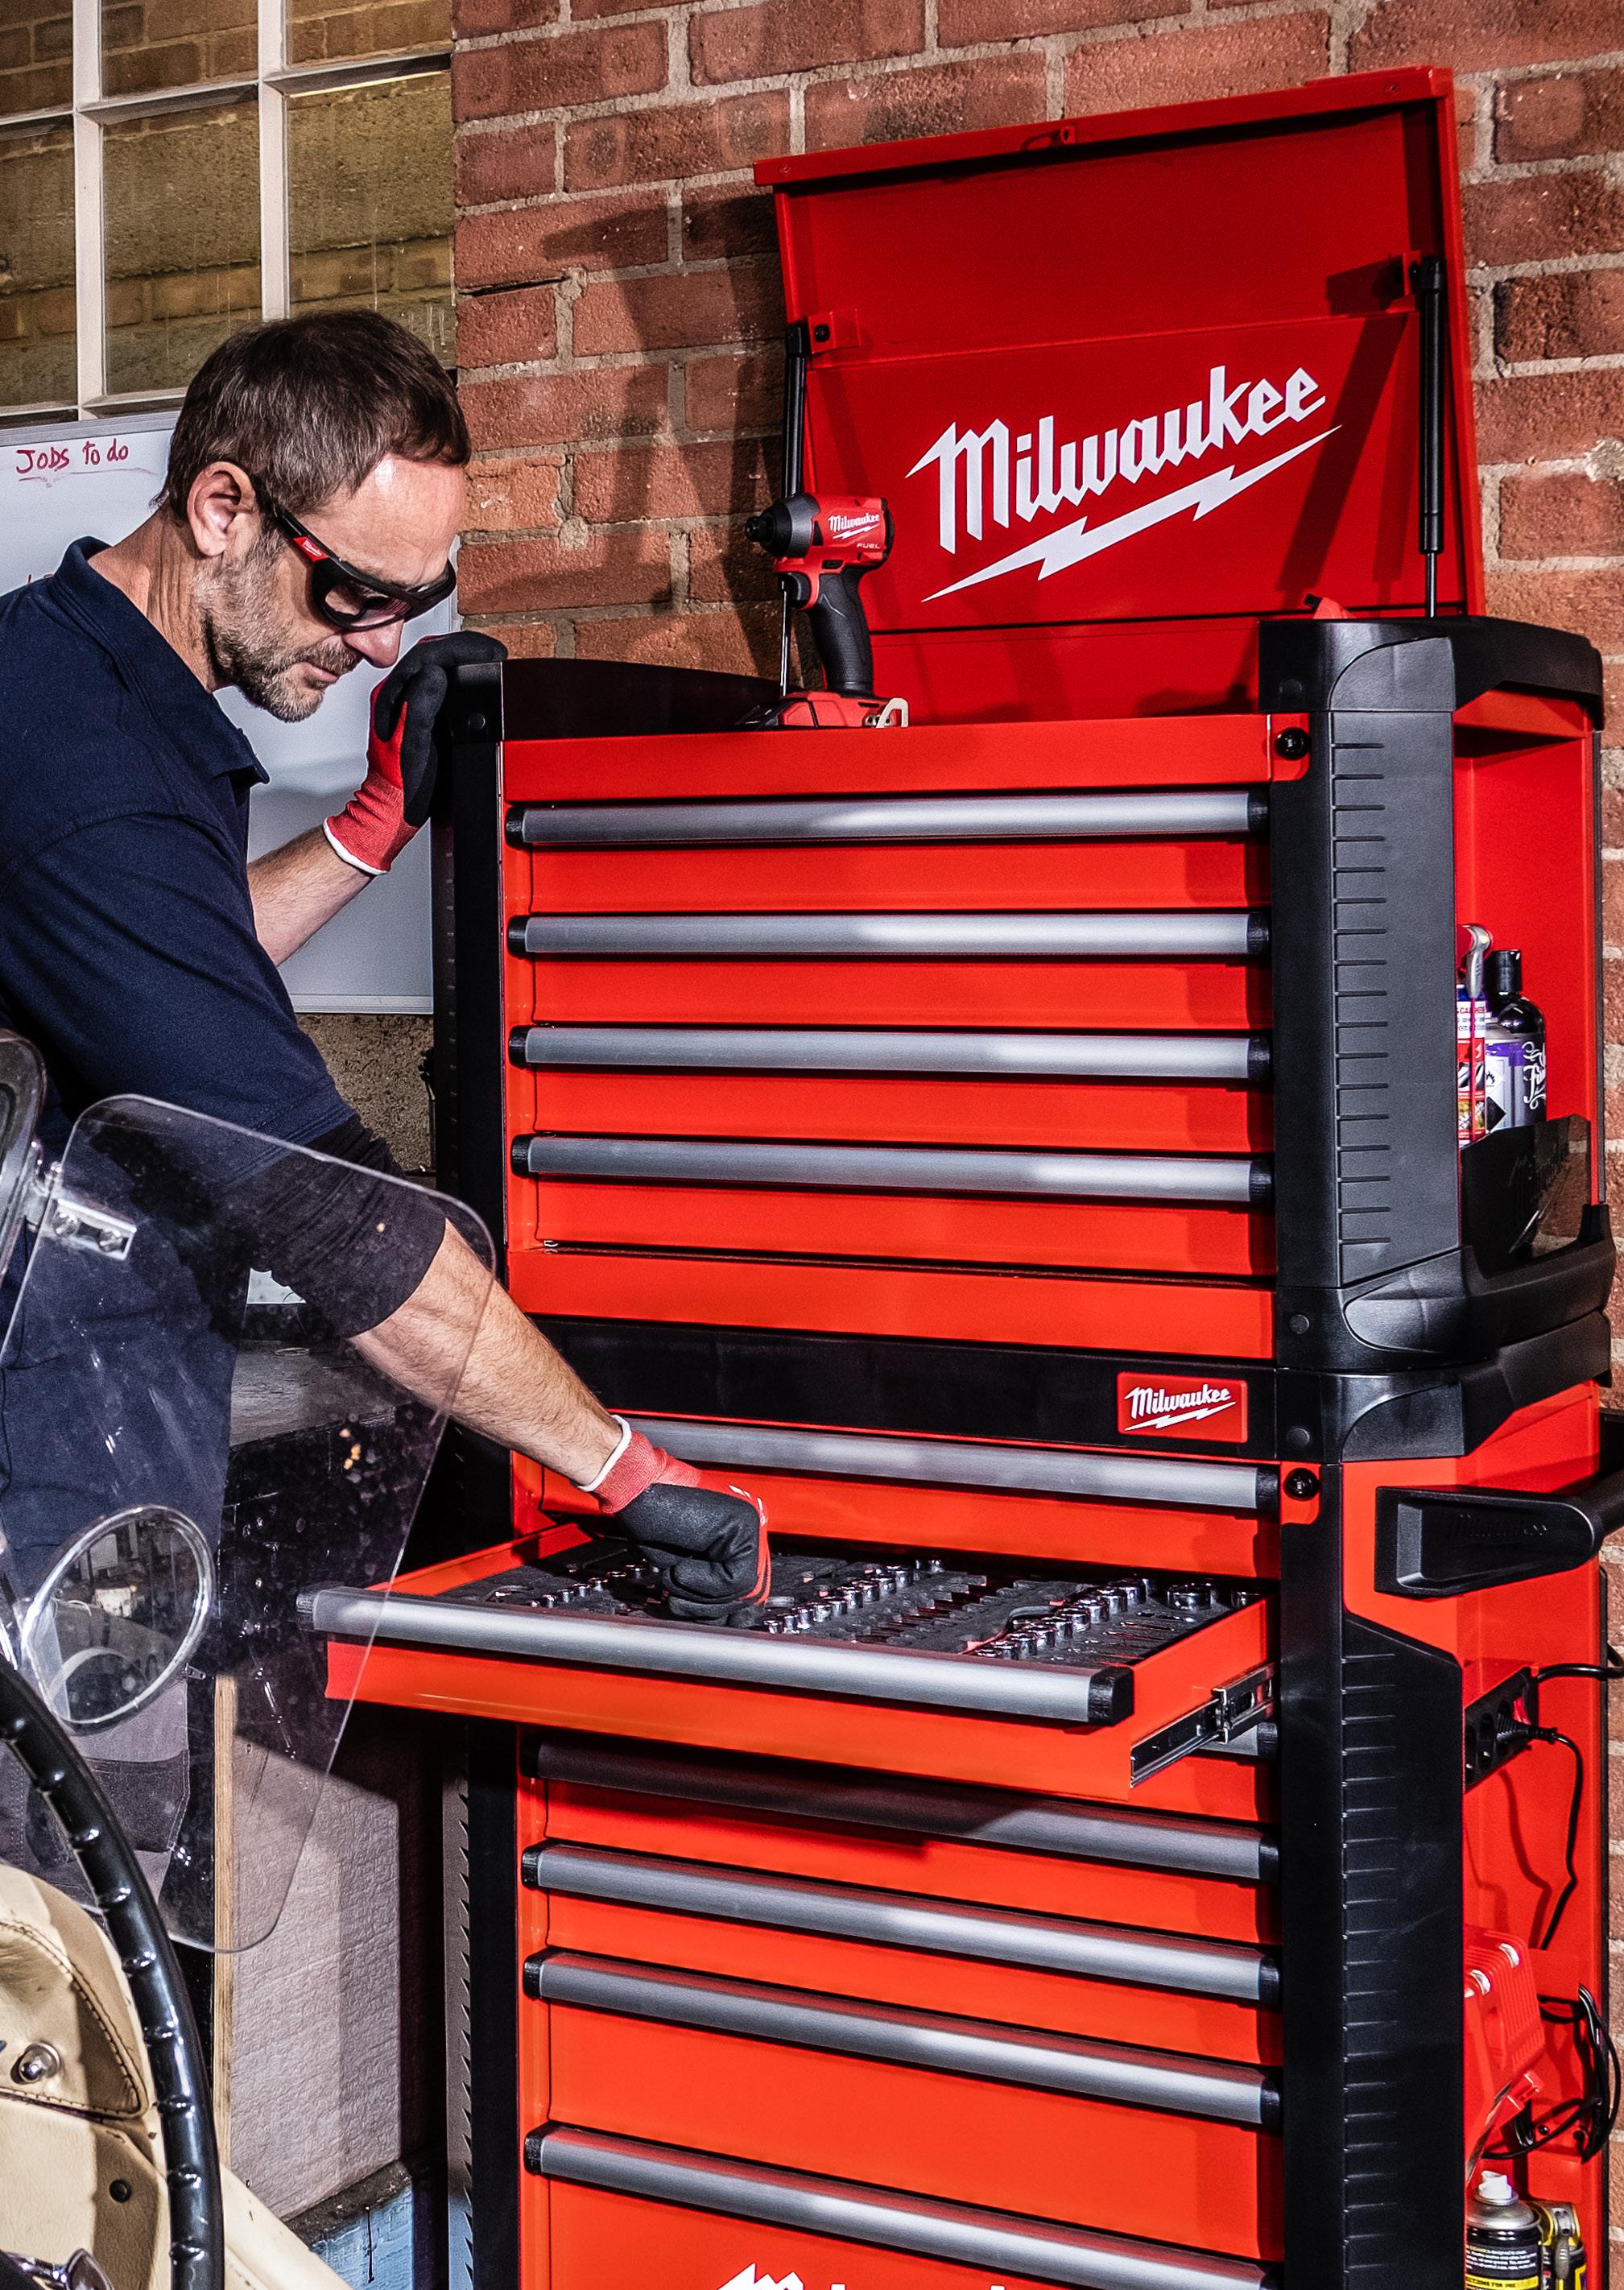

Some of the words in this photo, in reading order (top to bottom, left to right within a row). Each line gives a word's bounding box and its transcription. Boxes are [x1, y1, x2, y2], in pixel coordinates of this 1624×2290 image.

[106, 438, 129, 461] do
[904, 365, 1326, 555] Milwaukee
[827, 512, 880, 532] Milwaukee
[1124, 1383, 1232, 1420] Milwaukee
